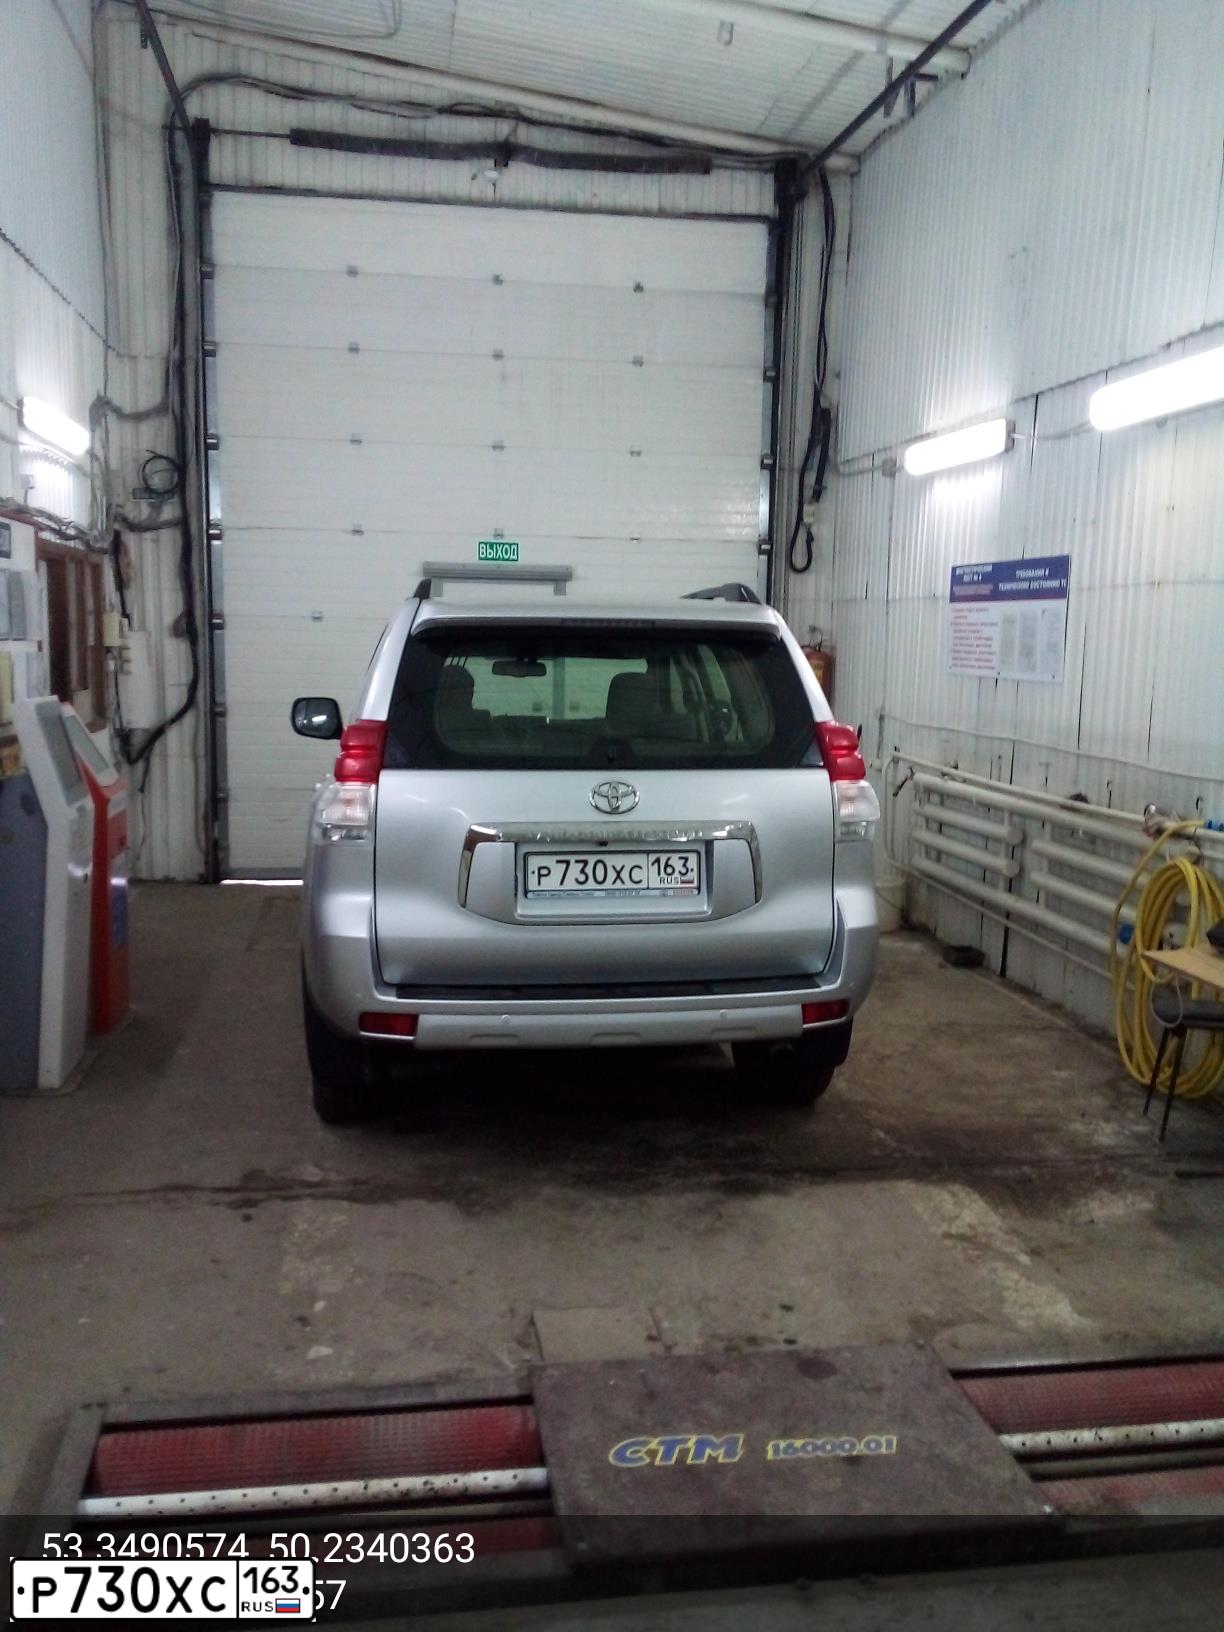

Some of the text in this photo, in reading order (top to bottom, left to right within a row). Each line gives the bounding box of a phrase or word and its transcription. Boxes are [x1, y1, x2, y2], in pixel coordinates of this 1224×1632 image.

[479, 543, 518, 561] ВЫХОД
[537, 856, 690, 886] Р730ХС 163
[659, 877, 680, 886] RUS
